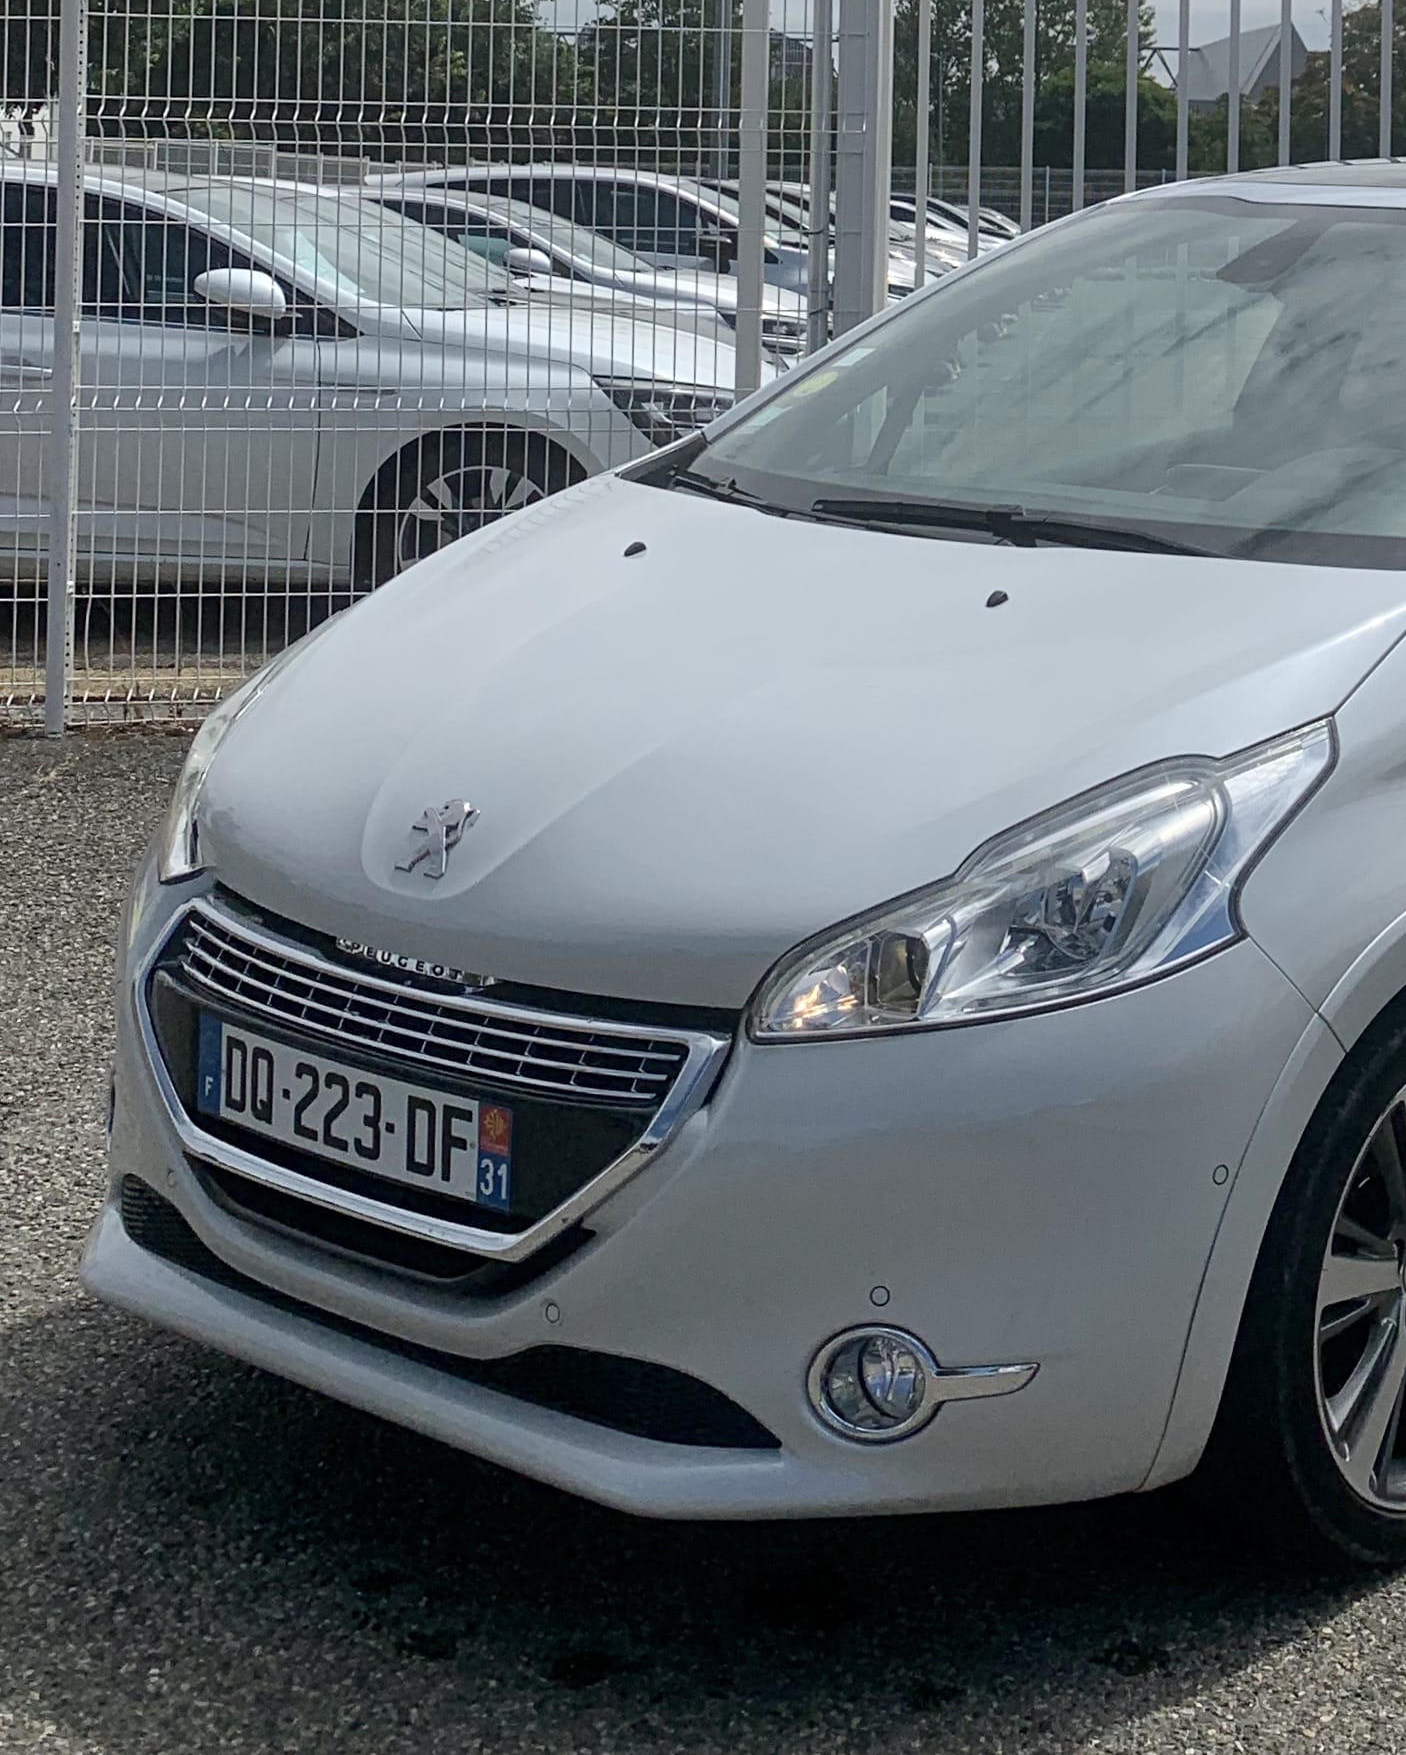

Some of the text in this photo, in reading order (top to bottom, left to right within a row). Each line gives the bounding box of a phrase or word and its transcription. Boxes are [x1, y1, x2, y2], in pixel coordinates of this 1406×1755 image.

[350, 940, 464, 982] PEUGEOT
[204, 1075, 214, 1097] F
[479, 1158, 508, 1200] 31
